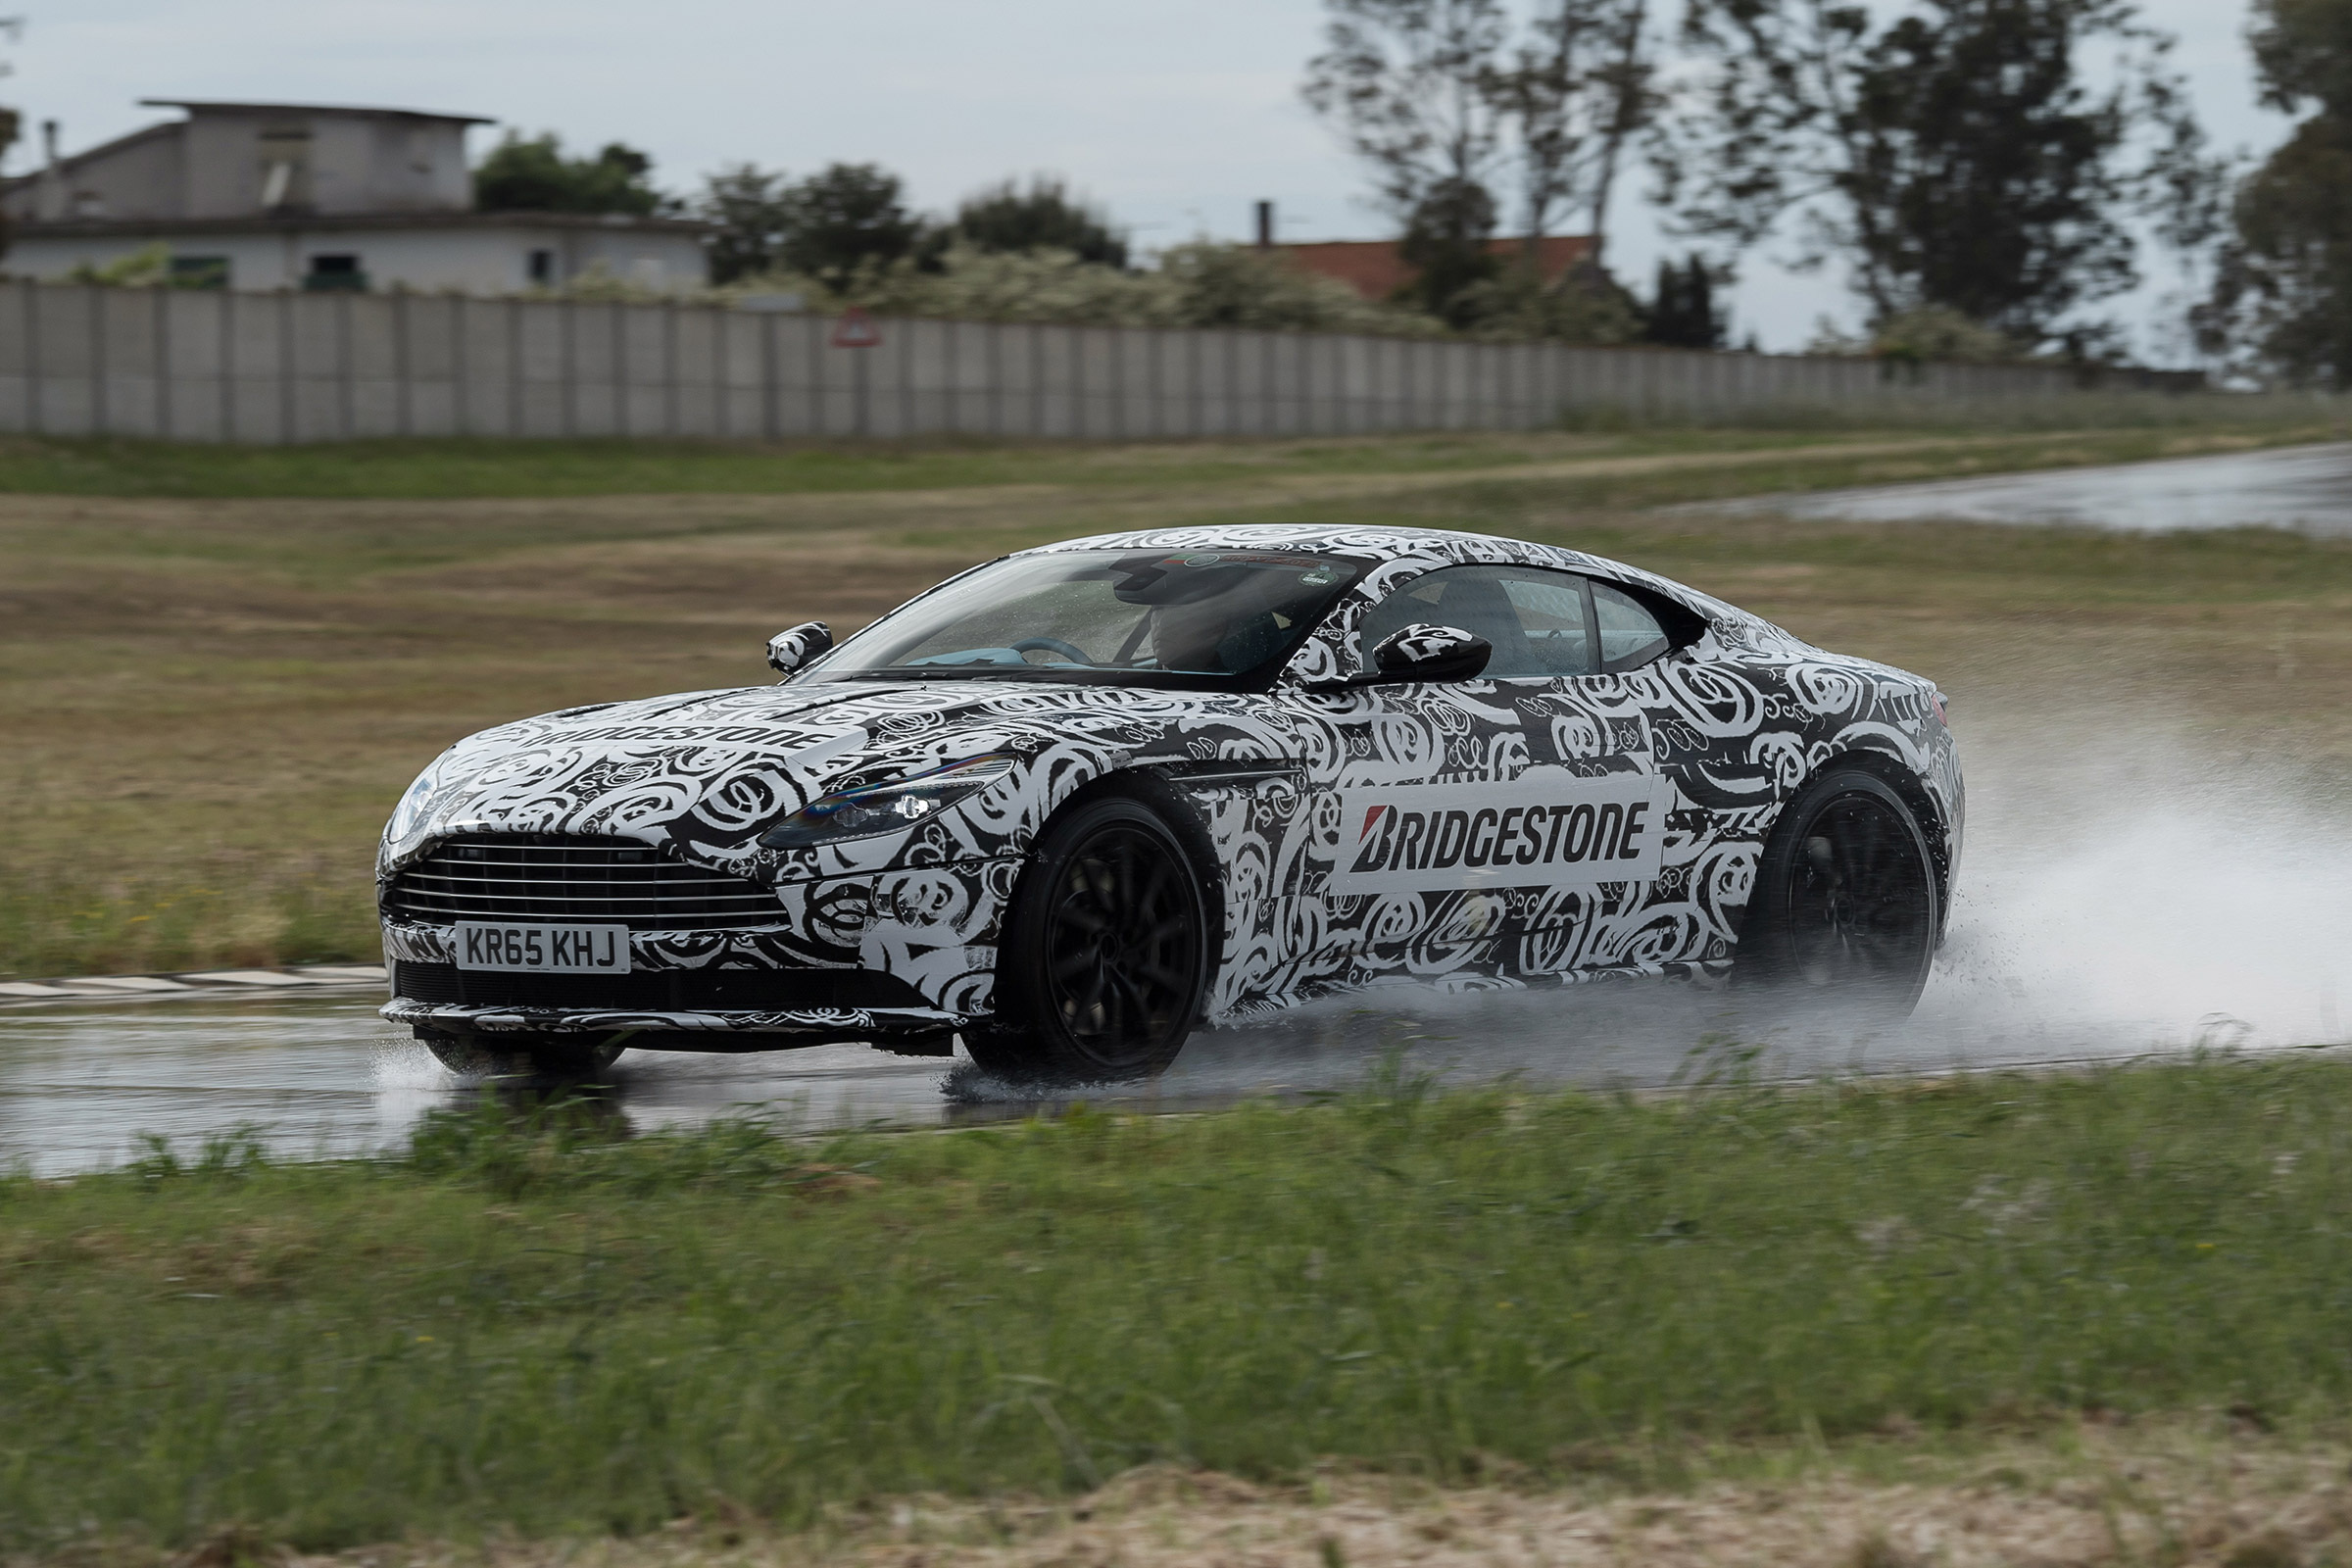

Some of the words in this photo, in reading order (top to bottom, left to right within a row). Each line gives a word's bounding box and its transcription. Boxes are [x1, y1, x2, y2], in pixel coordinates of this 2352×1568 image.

[1348, 802, 1649, 873] BRIDGESTONE
[466, 927, 543, 965] KR65
[552, 930, 615, 967] KHJ
